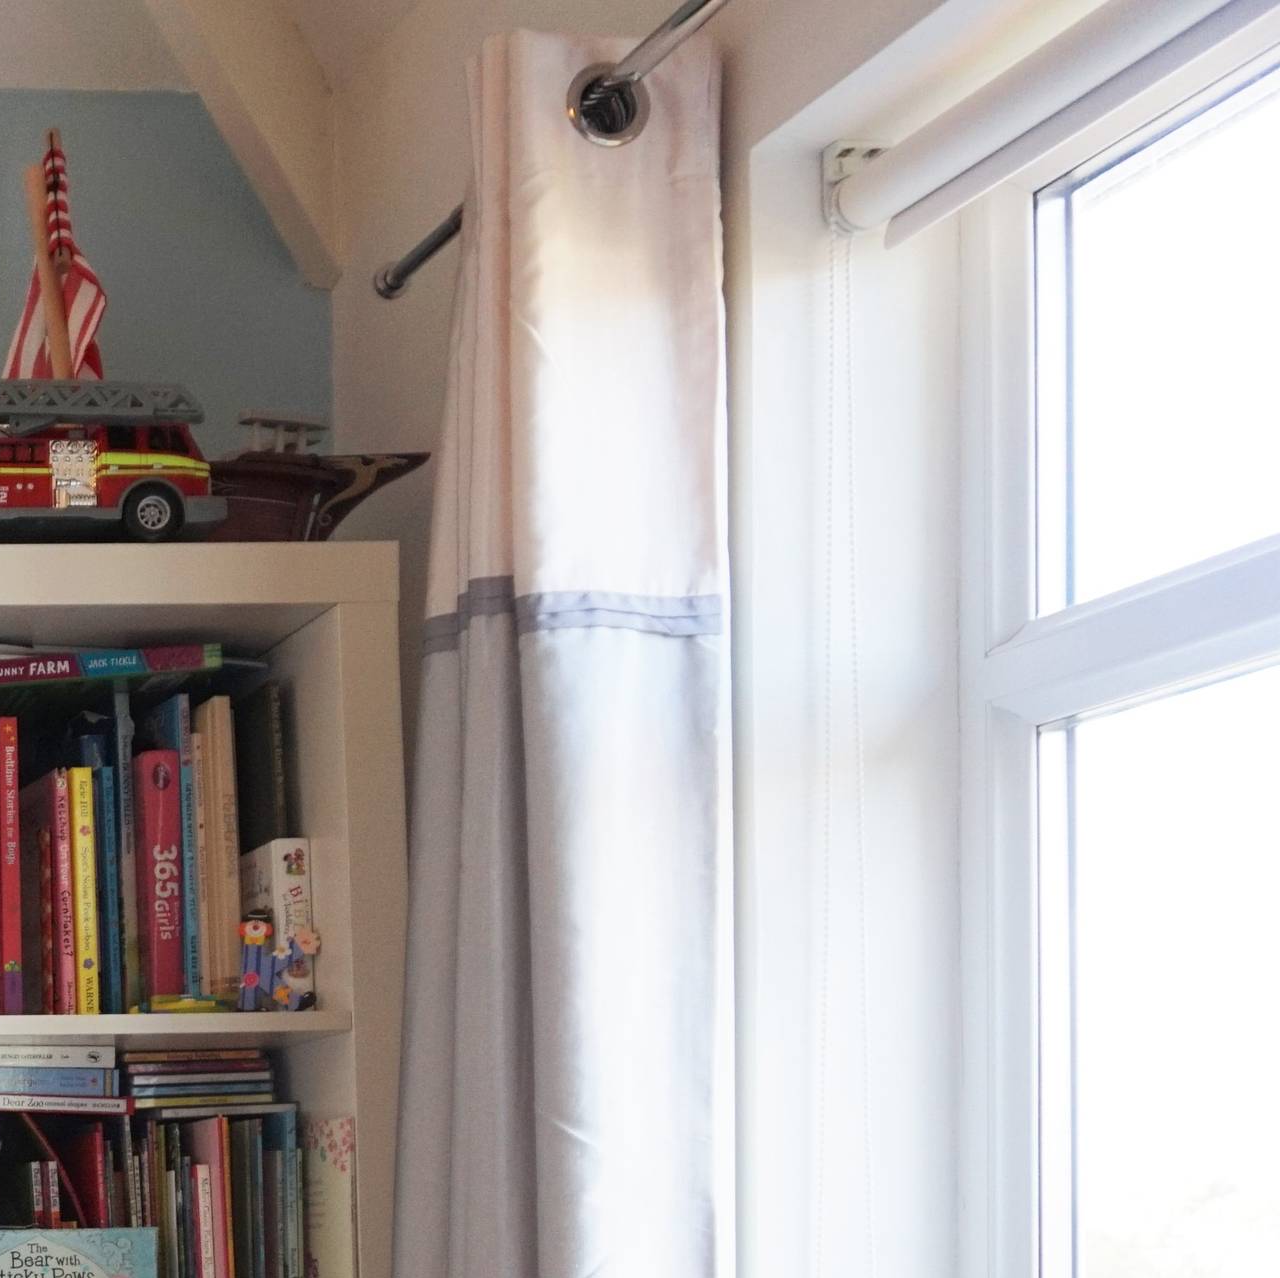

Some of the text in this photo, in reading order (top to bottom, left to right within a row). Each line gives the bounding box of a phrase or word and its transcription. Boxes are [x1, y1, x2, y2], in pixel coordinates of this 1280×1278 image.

[28, 660, 70, 677] FARM
[5, 745, 16, 786] Bedtime
[5, 789, 17, 825] Stories
[56, 796, 66, 841] Ketchup
[5, 841, 17, 865] Boys
[153, 844, 179, 898] 365
[155, 900, 176, 941] Girls
[86, 976, 94, 1013] WARNE
[2, 1096, 26, 1107] Dear
[27, 1097, 44, 1108] Zoo
[10, 1250, 81, 1270] Bear with
[27, 1242, 49, 1254] The
